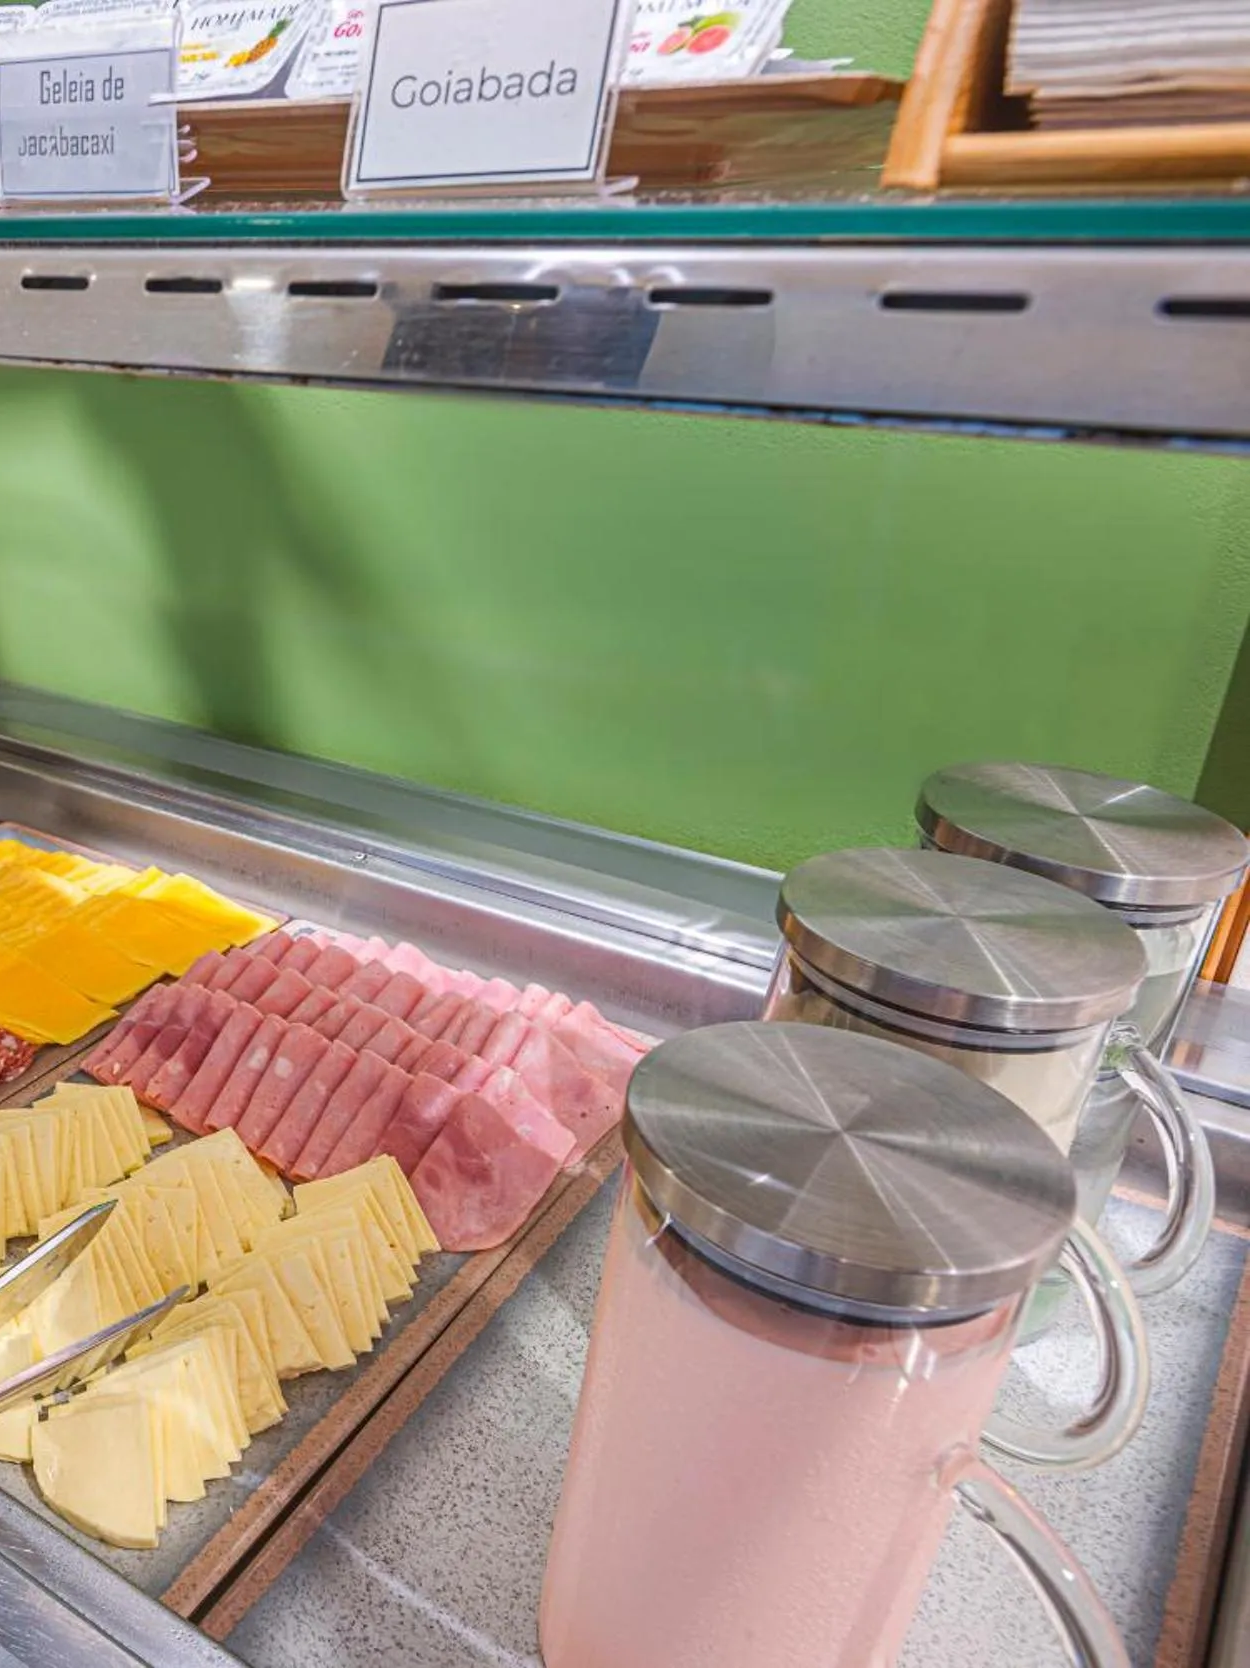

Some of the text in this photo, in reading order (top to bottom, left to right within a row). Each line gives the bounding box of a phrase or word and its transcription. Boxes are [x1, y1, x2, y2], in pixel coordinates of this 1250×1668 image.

[39, 65, 124, 105] Geleia de
[391, 60, 578, 108] Goiabada
